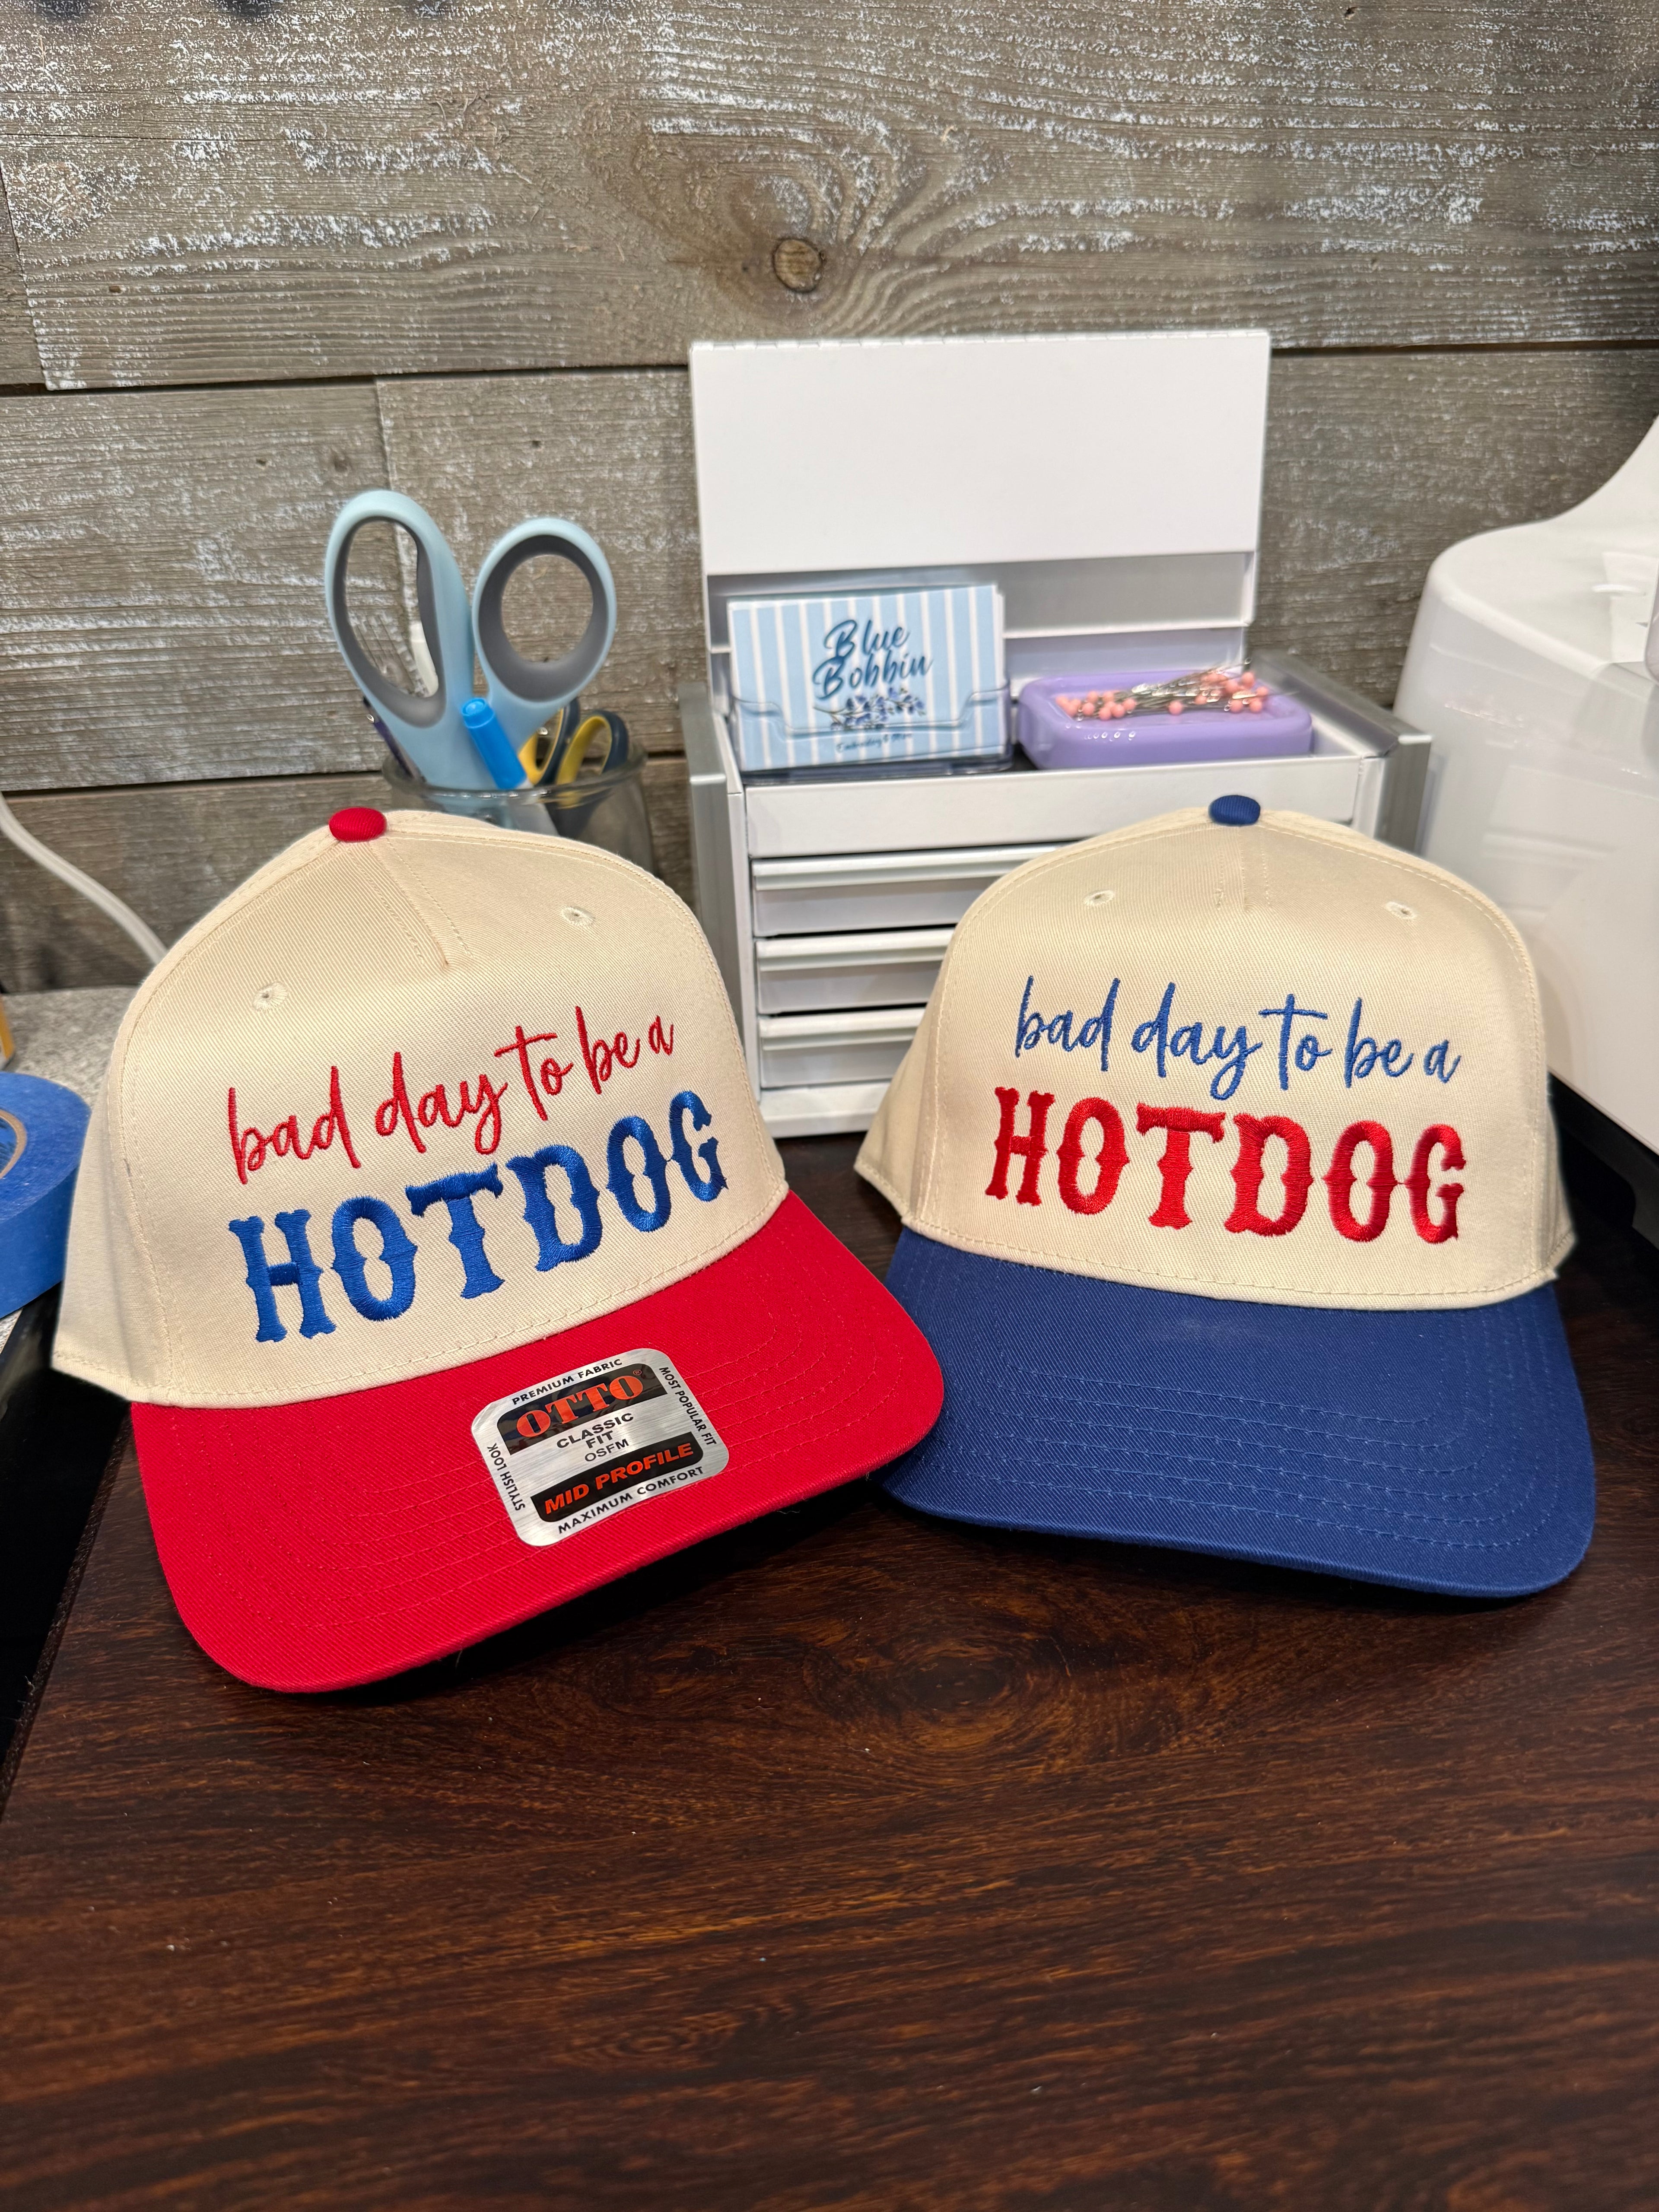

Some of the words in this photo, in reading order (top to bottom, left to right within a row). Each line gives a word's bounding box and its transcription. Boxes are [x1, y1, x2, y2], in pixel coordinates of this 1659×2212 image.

[824, 620, 910, 658] Blue
[813, 650, 933, 700] Bobbin
[1015, 976, 1120, 1071] bad
[1131, 982, 1262, 1100] day
[1259, 994, 1332, 1090] to
[1344, 997, 1414, 1088] be
[1424, 1039, 1462, 1083] a
[228, 1065, 361, 1184] bad
[375, 1052, 508, 1154] day
[495, 1026, 573, 1121] to
[575, 1006, 642, 1094] be
[649, 1015, 674, 1055] a
[985, 1086, 1466, 1244] HOTDOG
[229, 1090, 728, 1343] HOTDOG
[512, 1376, 574, 1405] PREMIUM
[578, 1359, 622, 1378] FABRIC
[659, 1367, 681, 1389] MOST
[675, 1390, 707, 1432] POPULAR
[701, 1433, 717, 1445] FIT
[556, 1413, 633, 1448] CLASSIC
[585, 1439, 629, 1462] OSFM
[586, 1430, 613, 1448] FIT
[487, 1443, 507, 1471] LOOK
[545, 1484, 589, 1514] MID
[595, 1443, 693, 1490] PROFILE
[500, 1471, 525, 1511] STYLISH
[558, 1493, 633, 1534] MAXIMUM
[637, 1466, 703, 1494] COMFORT
